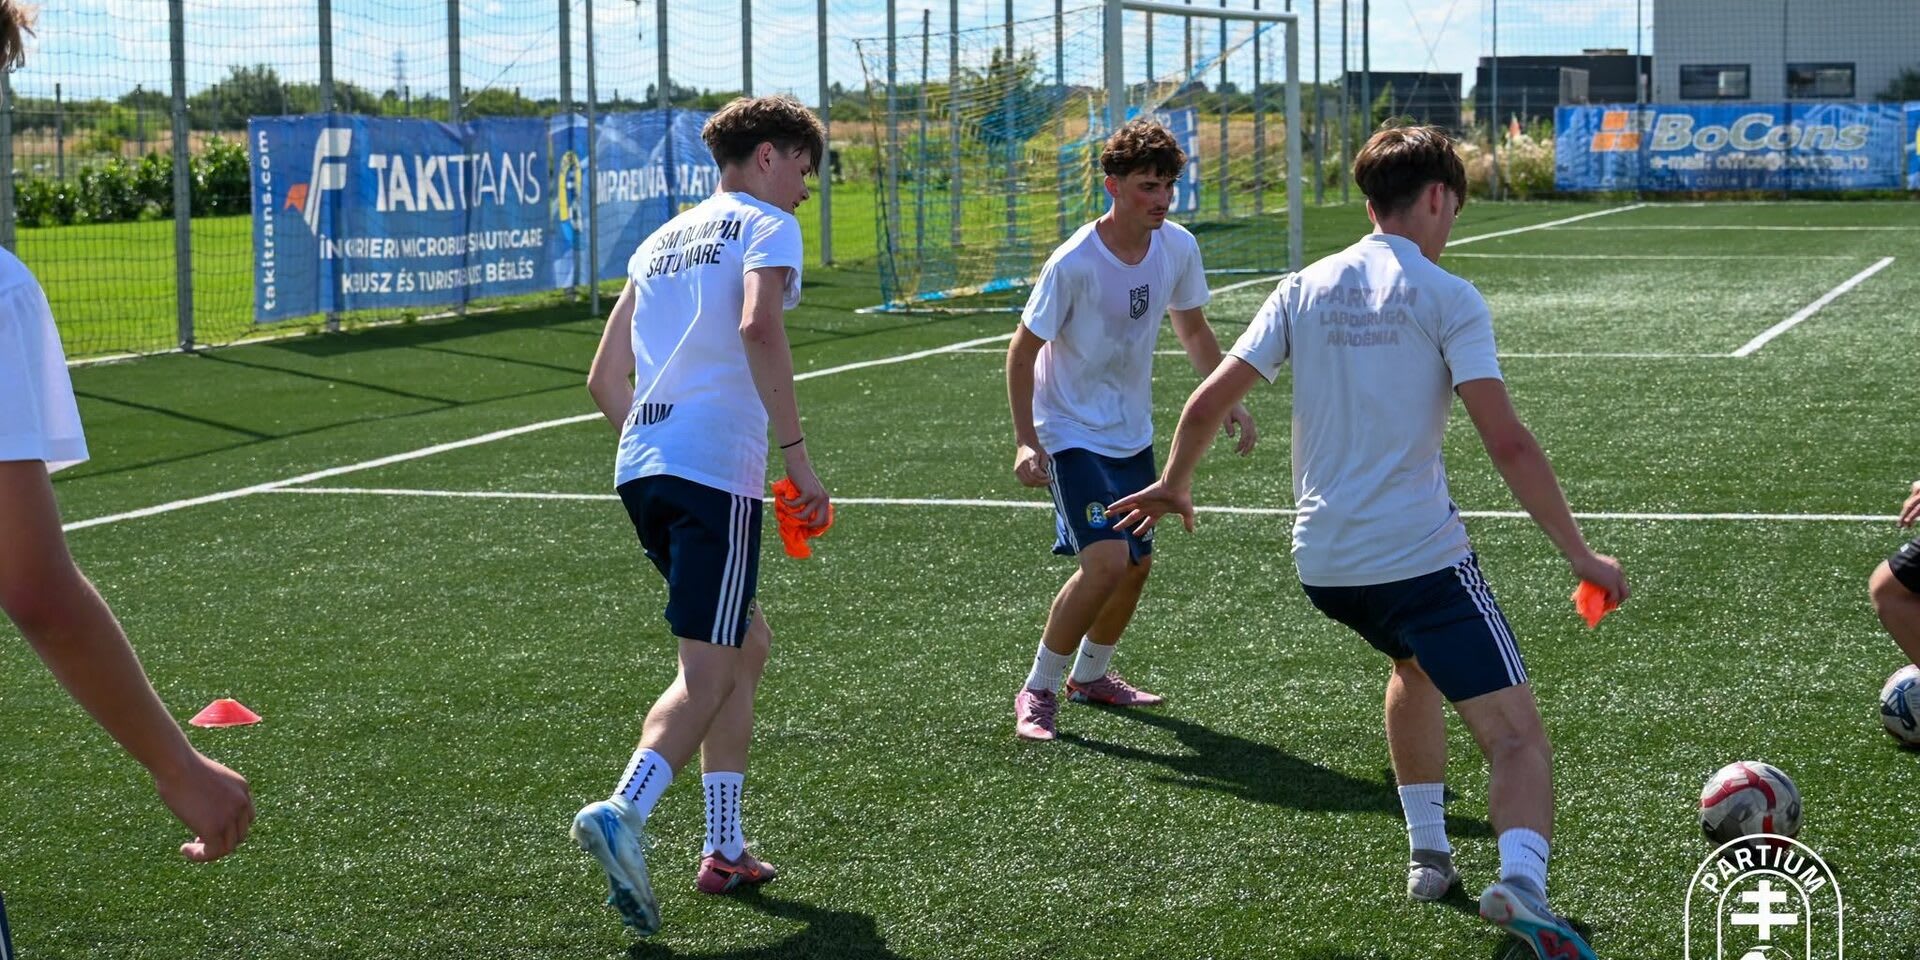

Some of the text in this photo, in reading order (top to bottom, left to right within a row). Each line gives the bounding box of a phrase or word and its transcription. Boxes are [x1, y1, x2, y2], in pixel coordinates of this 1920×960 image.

[1650, 113, 1868, 151] BoCons
[258, 130, 276, 311] takitrans.com
[683, 220, 741, 247] OLIMPIA
[646, 243, 725, 278] SATU MARE
[397, 267, 415, 293] ÉS
